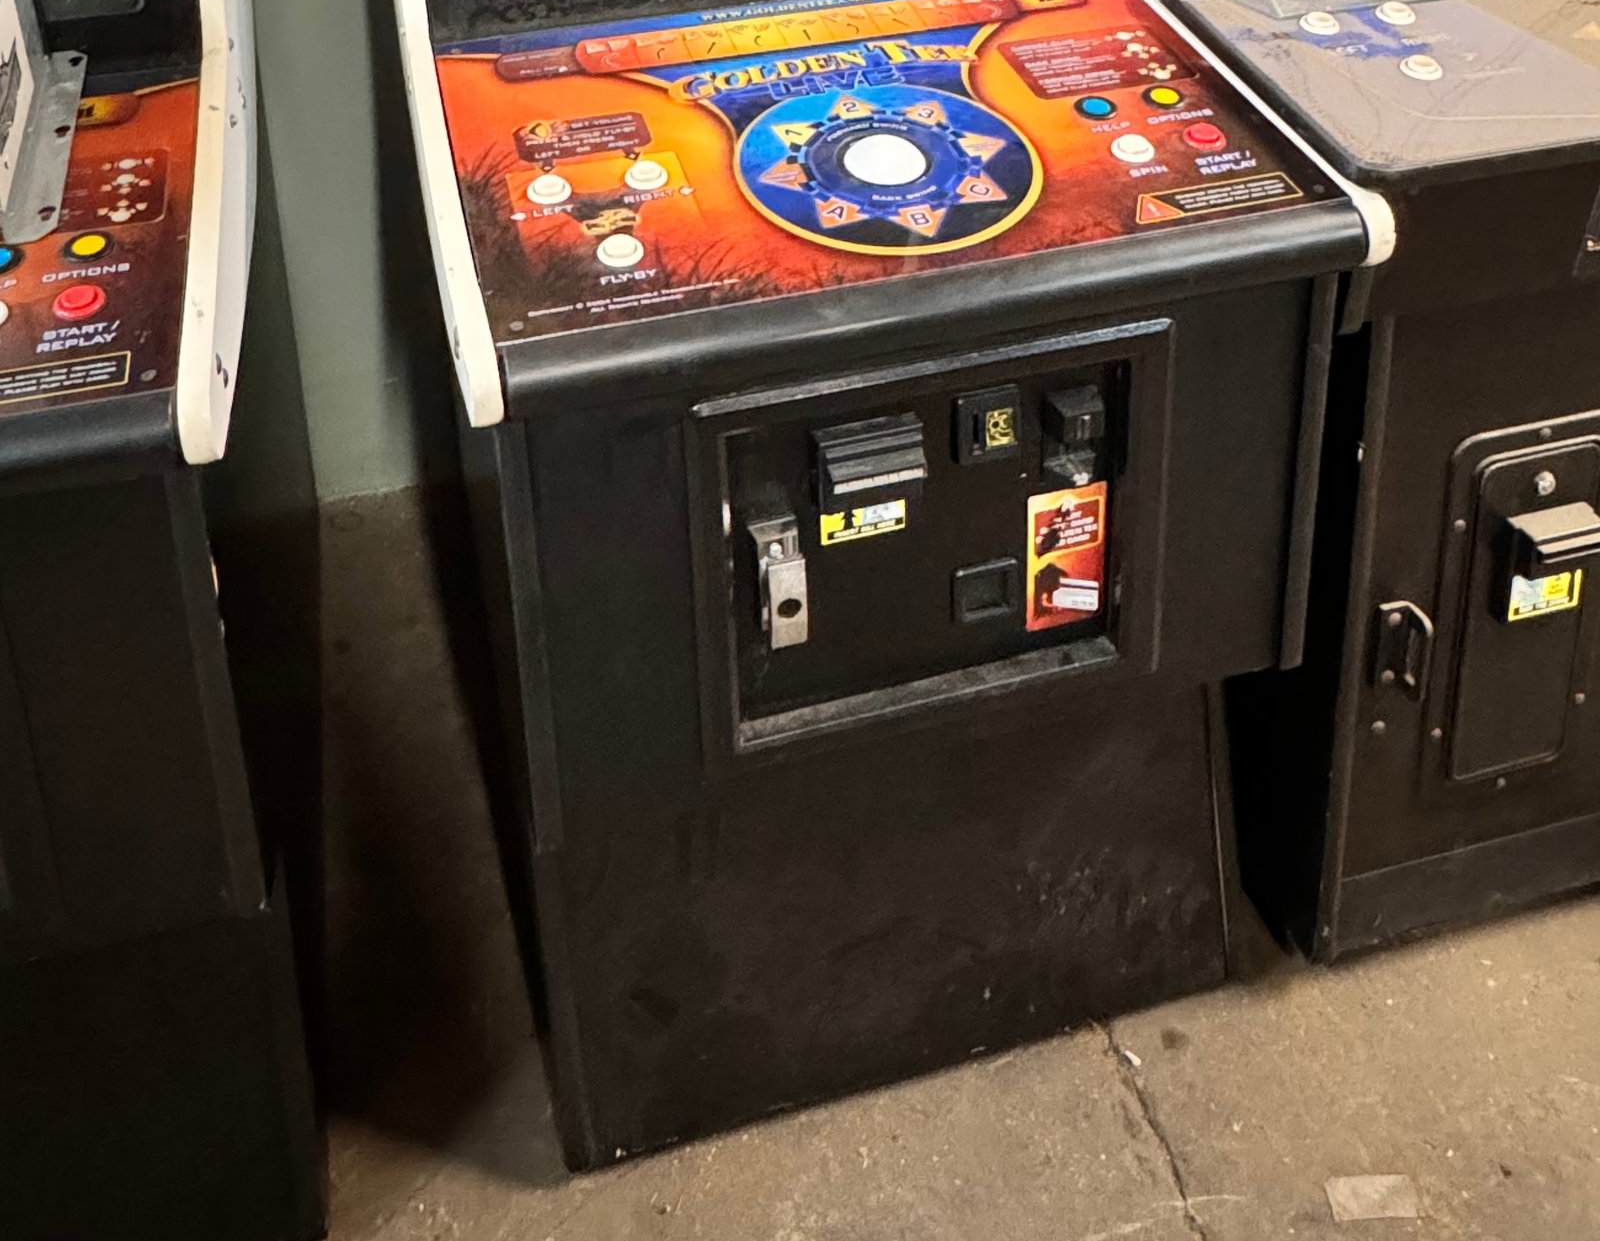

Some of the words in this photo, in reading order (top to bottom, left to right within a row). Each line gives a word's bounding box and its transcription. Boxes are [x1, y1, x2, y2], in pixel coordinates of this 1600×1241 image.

[669, 49, 867, 102] GOLDEN
[842, 101, 859, 113] 2
[917, 106, 936, 119] 3
[1147, 109, 1213, 125] OPTIONS
[785, 127, 804, 138] 1
[1091, 121, 1130, 133] HELP
[535, 151, 560, 159] LEFT
[1195, 152, 1242, 166] START
[1129, 165, 1169, 178] SPIN
[1200, 158, 1257, 175] REPLAY
[623, 189, 675, 204] RIGHT
[969, 183, 990, 197] C
[532, 204, 574, 217] LEFT
[827, 205, 846, 220] A
[910, 212, 930, 227] B
[42, 263, 130, 283] OPTIONS
[600, 268, 657, 285] FLY-BY
[43, 323, 108, 340] START
[36, 333, 117, 353] REPLAY
